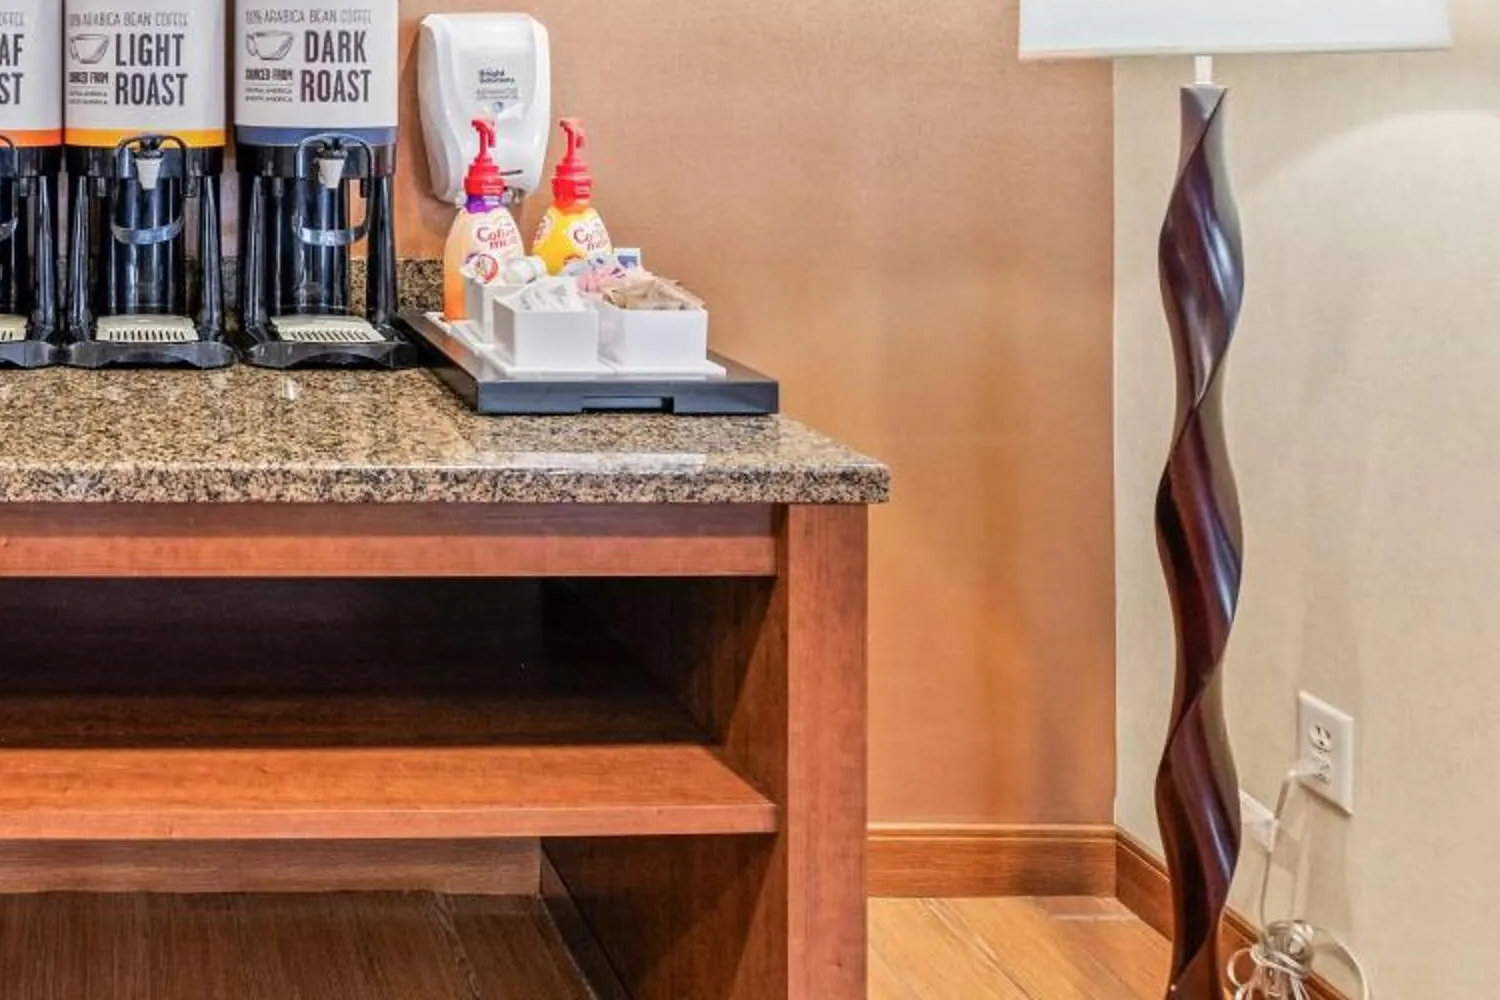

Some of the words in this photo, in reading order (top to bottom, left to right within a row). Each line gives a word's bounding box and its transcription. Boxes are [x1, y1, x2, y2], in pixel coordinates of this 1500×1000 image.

[115, 33, 185, 66] LIGHT
[305, 29, 367, 63] DARK
[115, 72, 189, 106] ROAST
[300, 69, 372, 102] ROAST
